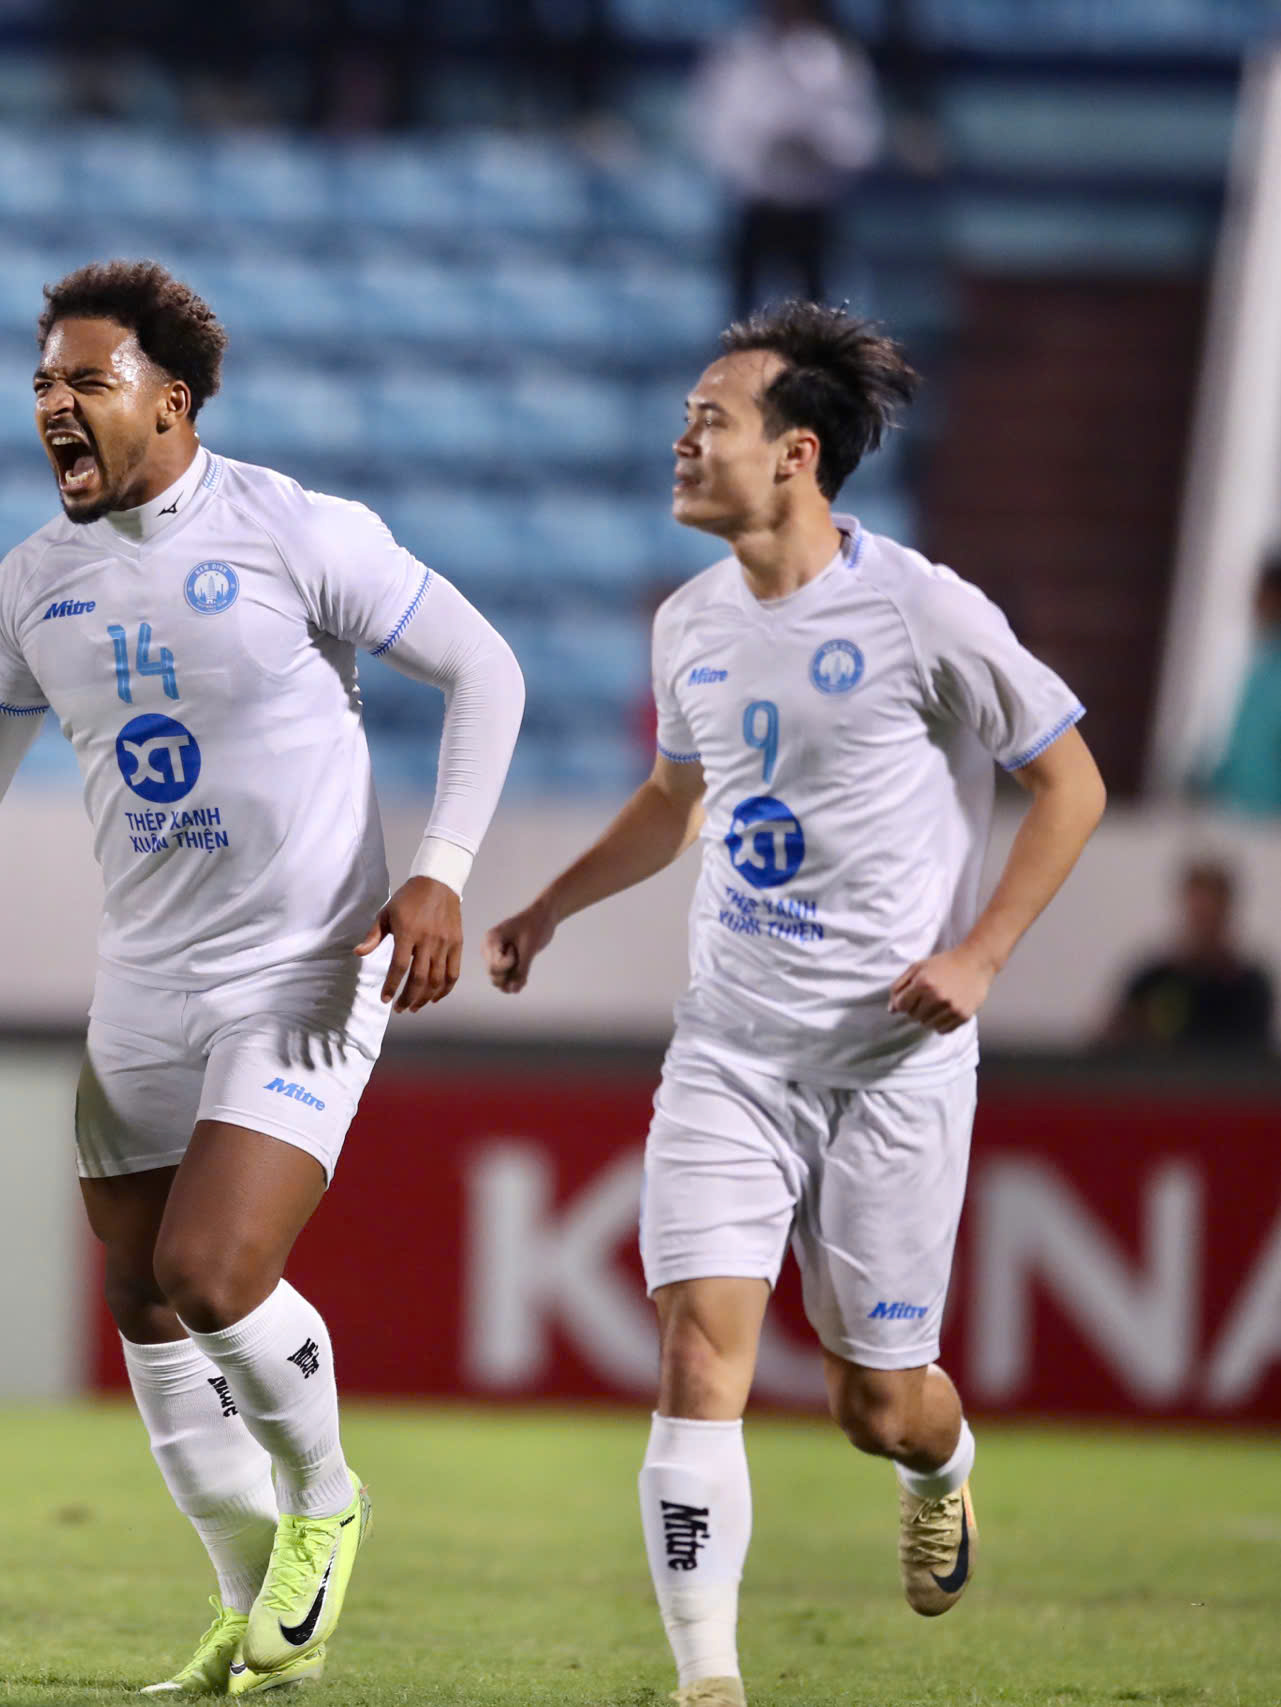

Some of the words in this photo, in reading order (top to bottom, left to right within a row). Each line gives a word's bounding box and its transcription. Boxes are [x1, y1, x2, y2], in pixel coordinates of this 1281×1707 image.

[42, 599, 97, 620] Mitre
[106, 622, 180, 704] 14
[743, 700, 780, 785] 9
[125, 808, 167, 832] THÉP
[170, 807, 221, 831] XANH
[129, 833, 169, 854] XUÂN
[172, 828, 230, 854] THIỆN
[262, 1077, 326, 1112] Mitre
[660, 1499, 710, 1571] Mitre
